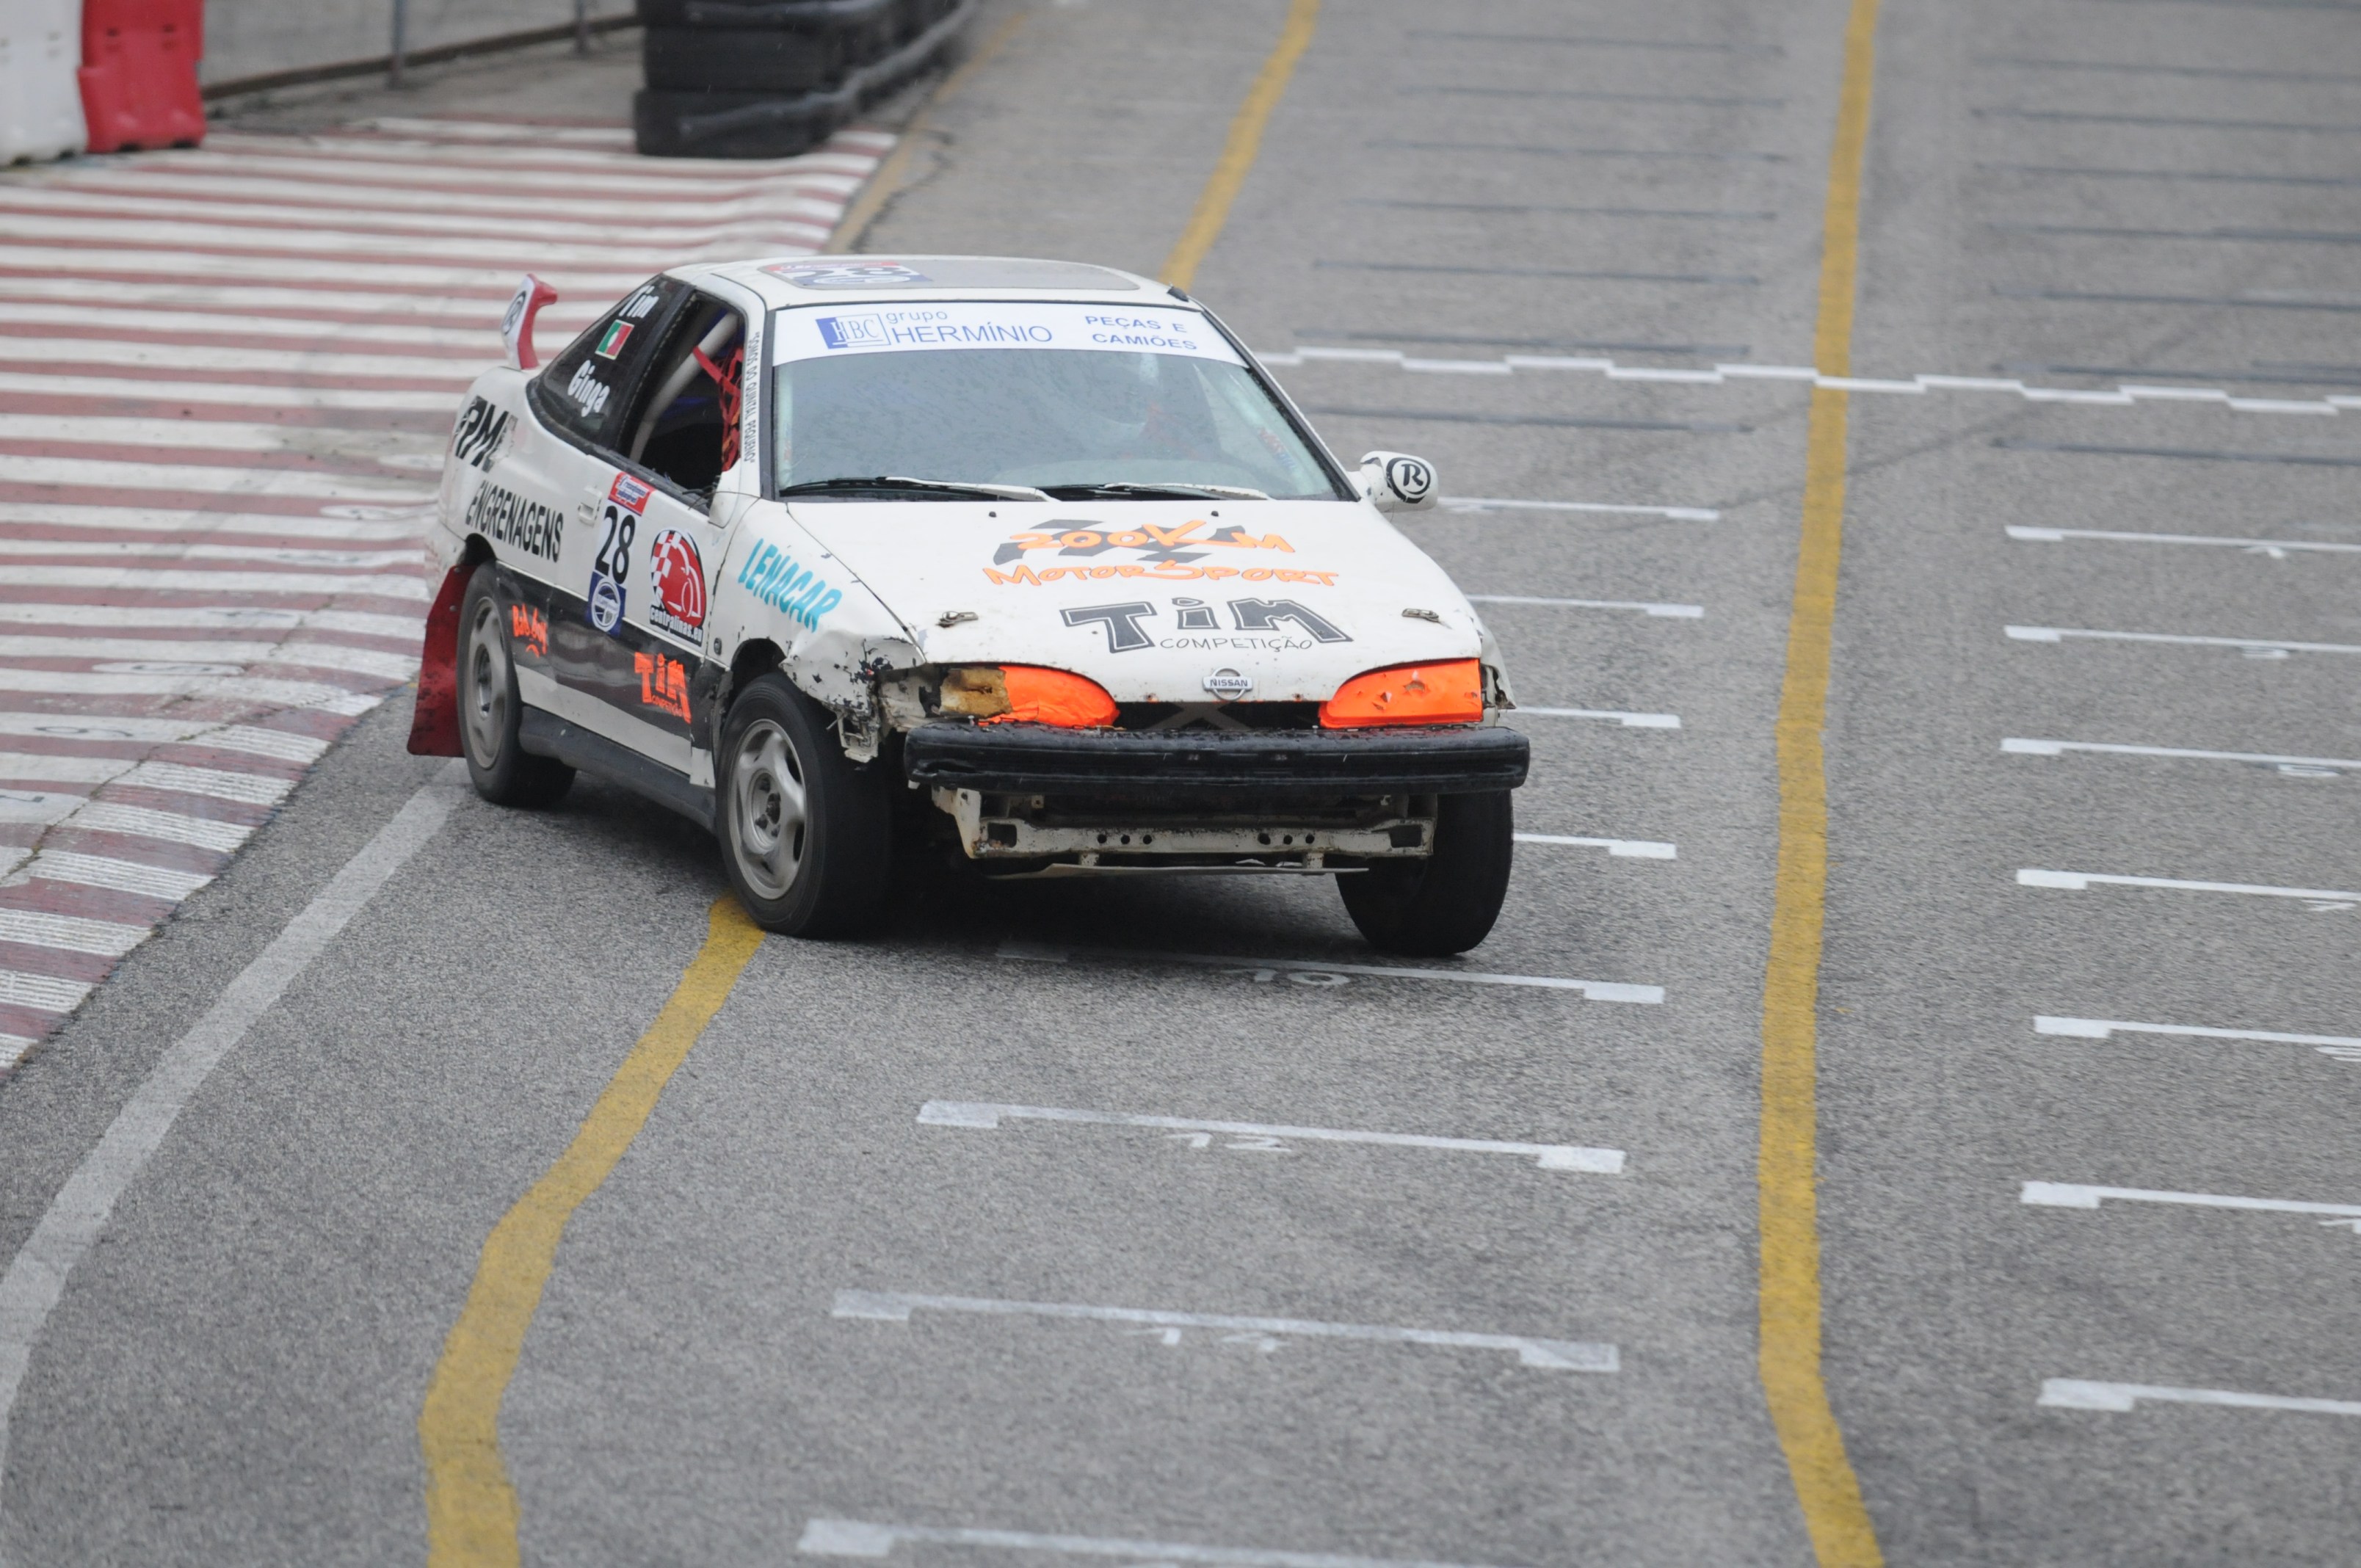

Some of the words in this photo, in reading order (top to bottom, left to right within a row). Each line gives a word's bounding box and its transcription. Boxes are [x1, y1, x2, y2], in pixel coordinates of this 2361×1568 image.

[885, 311, 948, 324] grupo
[1085, 316, 1161, 330] PEÇAS
[1172, 323, 1187, 333] E
[830, 318, 879, 342] HBC
[891, 322, 1053, 343] HERMÍNIO
[1092, 334, 1197, 350] CAMIÕES
[567, 360, 610, 417] Ginga
[465, 479, 563, 563] ENGRENAGENS
[595, 505, 636, 584] 28
[737, 537, 843, 634] LENACAR
[1160, 636, 1313, 652] COMPETIÇÃO
[1210, 678, 1248, 688] NISSAN
